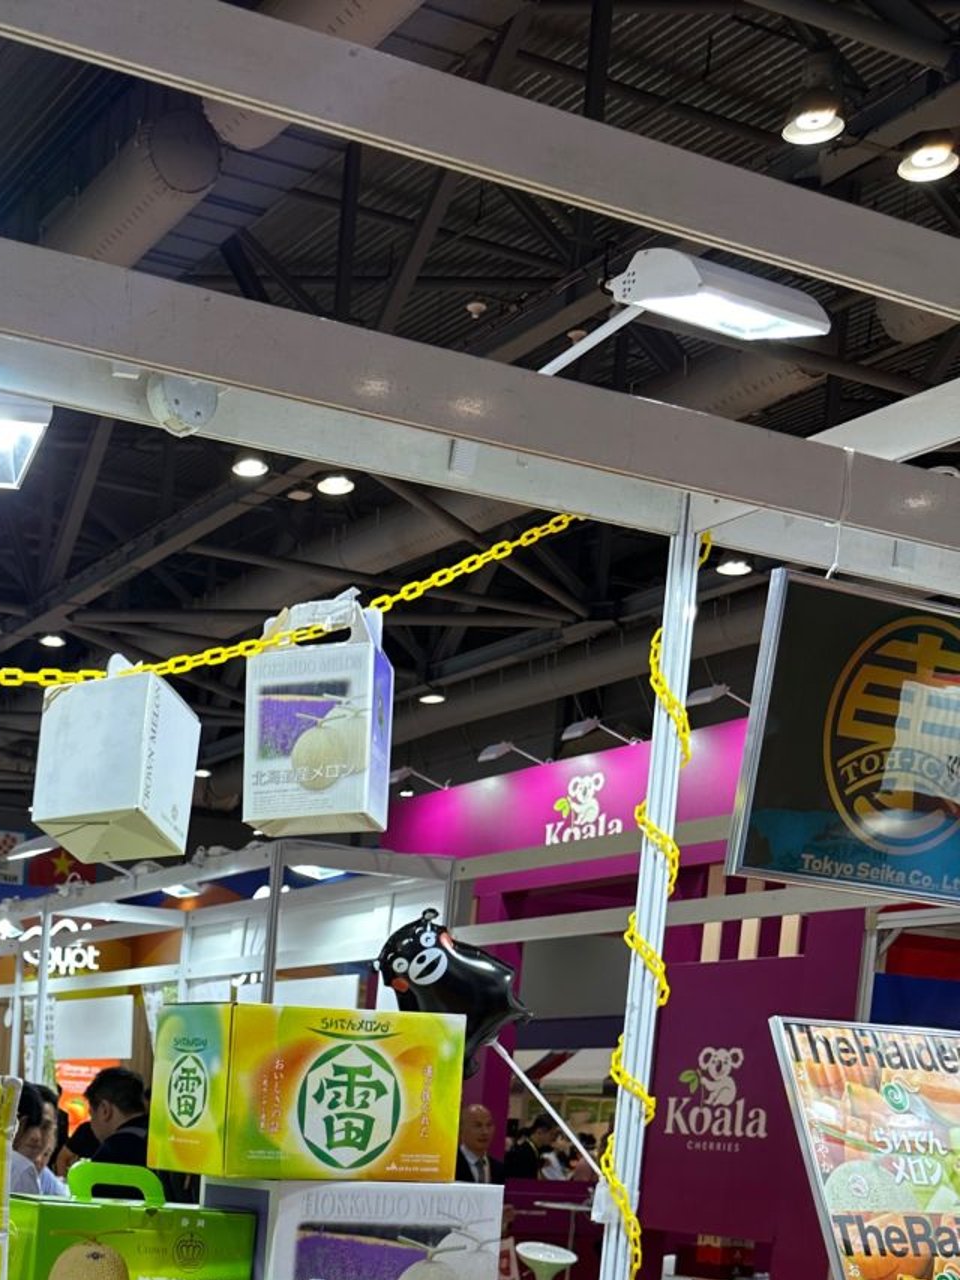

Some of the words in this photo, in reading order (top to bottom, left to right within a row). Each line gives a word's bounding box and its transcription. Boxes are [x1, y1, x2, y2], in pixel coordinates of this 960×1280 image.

[801, 853, 853, 880] Tokyo
[856, 861, 906, 885] Seika
[663, 1097, 768, 1138] Koala
[686, 1140, 740, 1153] CHERRIES
